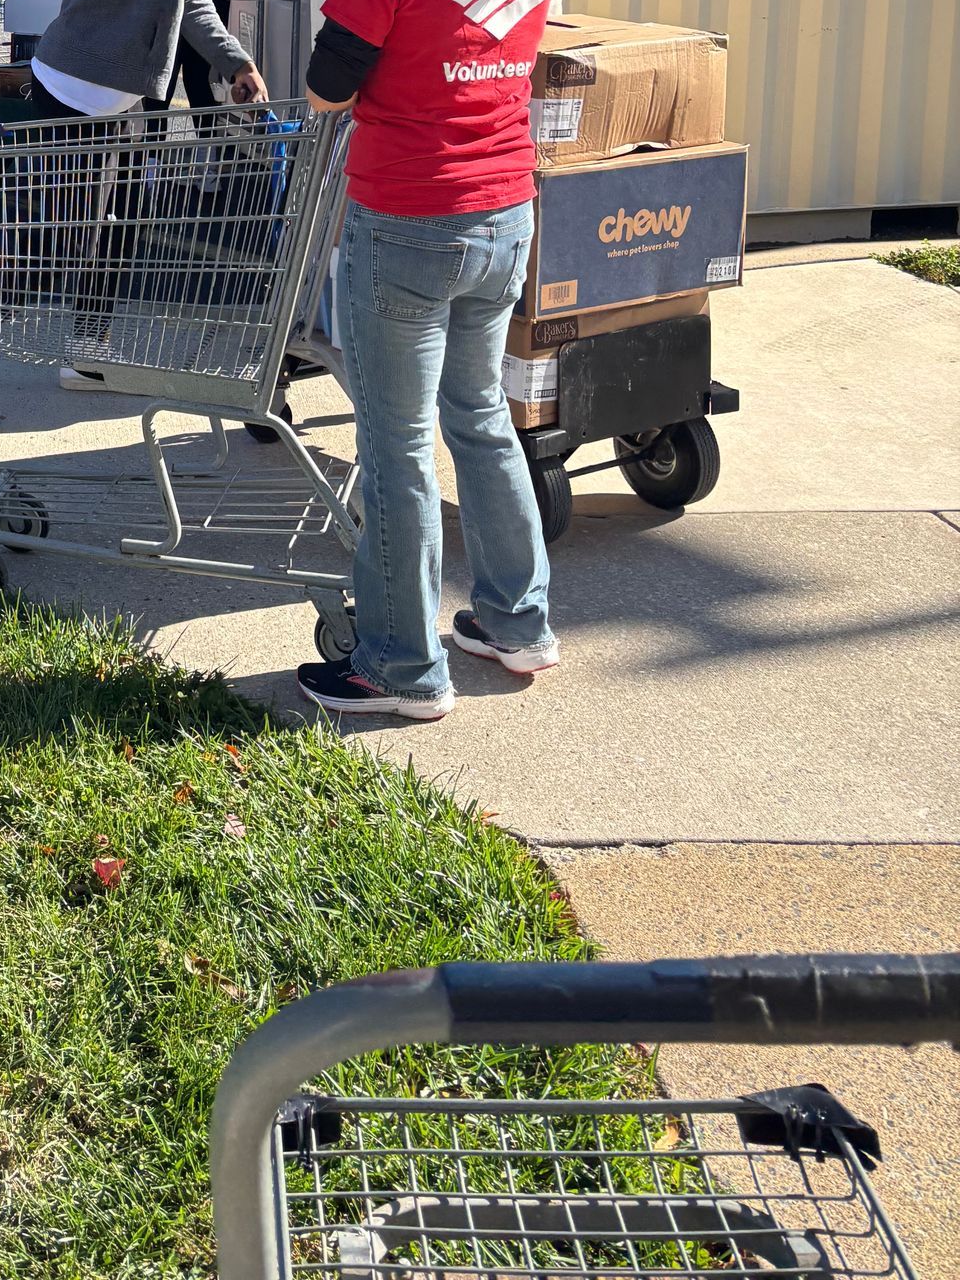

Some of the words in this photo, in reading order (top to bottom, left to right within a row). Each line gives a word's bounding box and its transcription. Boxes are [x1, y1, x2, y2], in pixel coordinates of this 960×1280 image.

[442, 60, 532, 82] Volunteer
[598, 205, 691, 244] chewy
[607, 249, 629, 258] where
[629, 246, 641, 256] pet
[642, 242, 662, 252] lovers
[663, 240, 680, 250] shop
